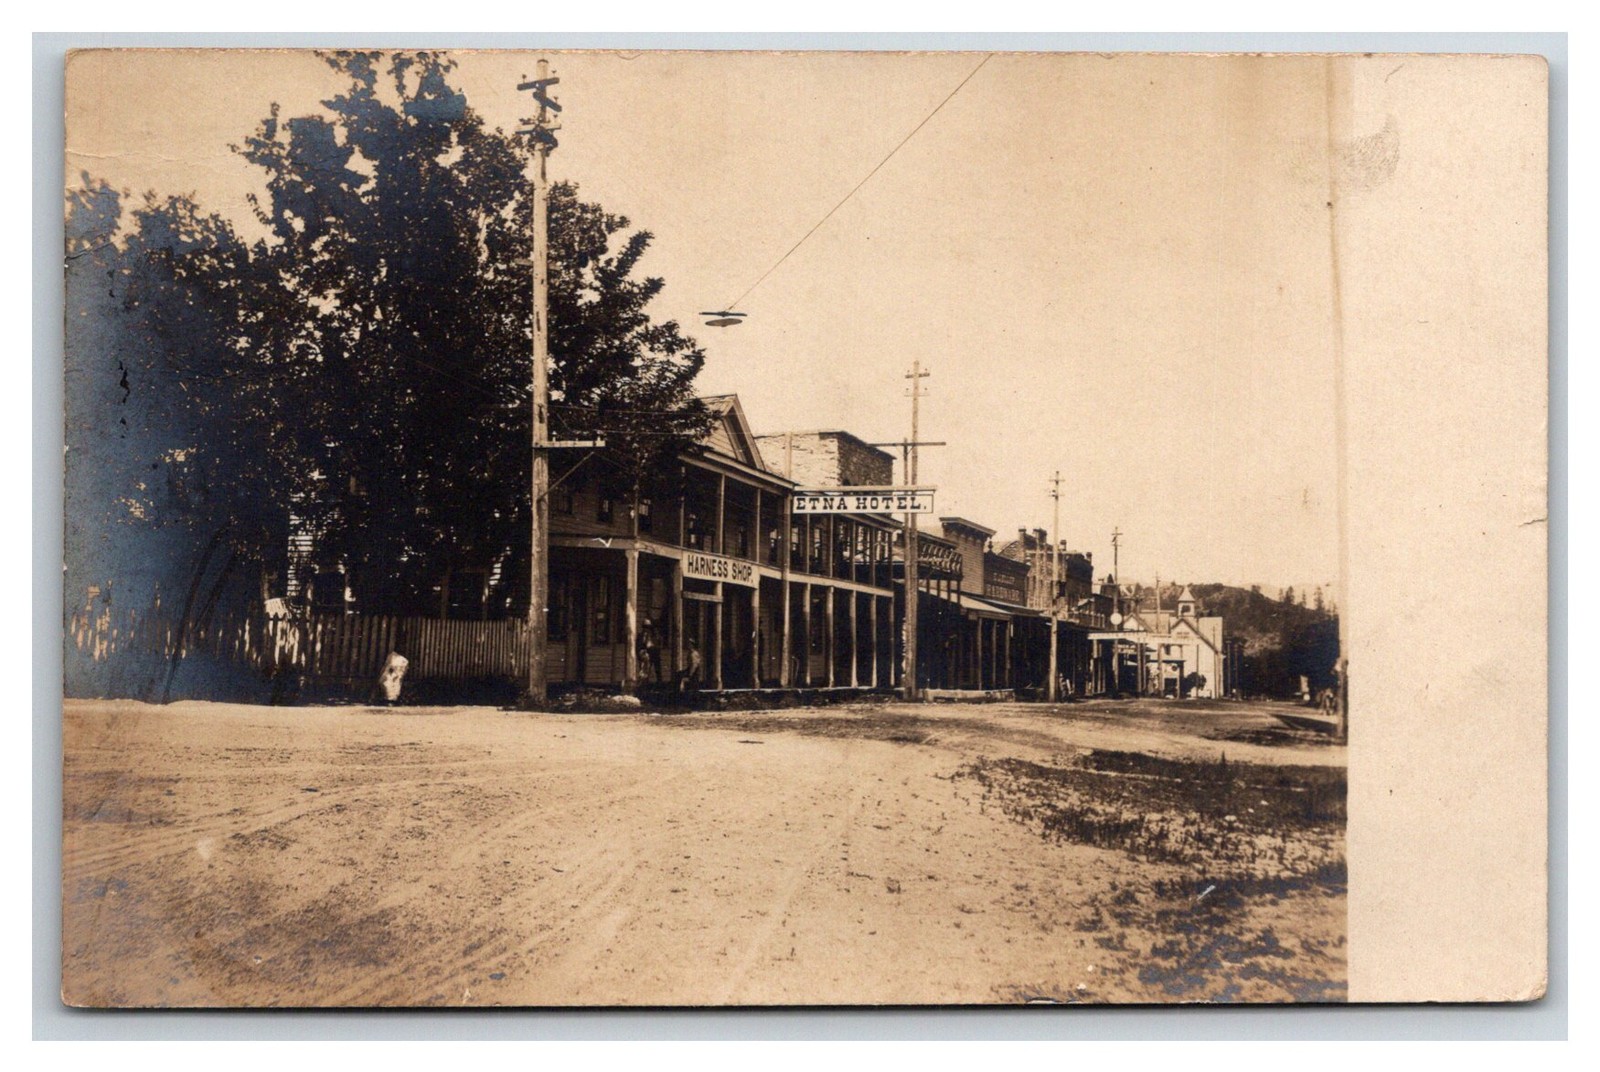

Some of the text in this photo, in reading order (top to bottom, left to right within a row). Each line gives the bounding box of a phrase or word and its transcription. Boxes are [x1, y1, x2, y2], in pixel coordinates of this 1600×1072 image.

[796, 496, 927, 510] ETNA HOTEL.
[688, 555, 754, 583] HARNESS SHOP.
